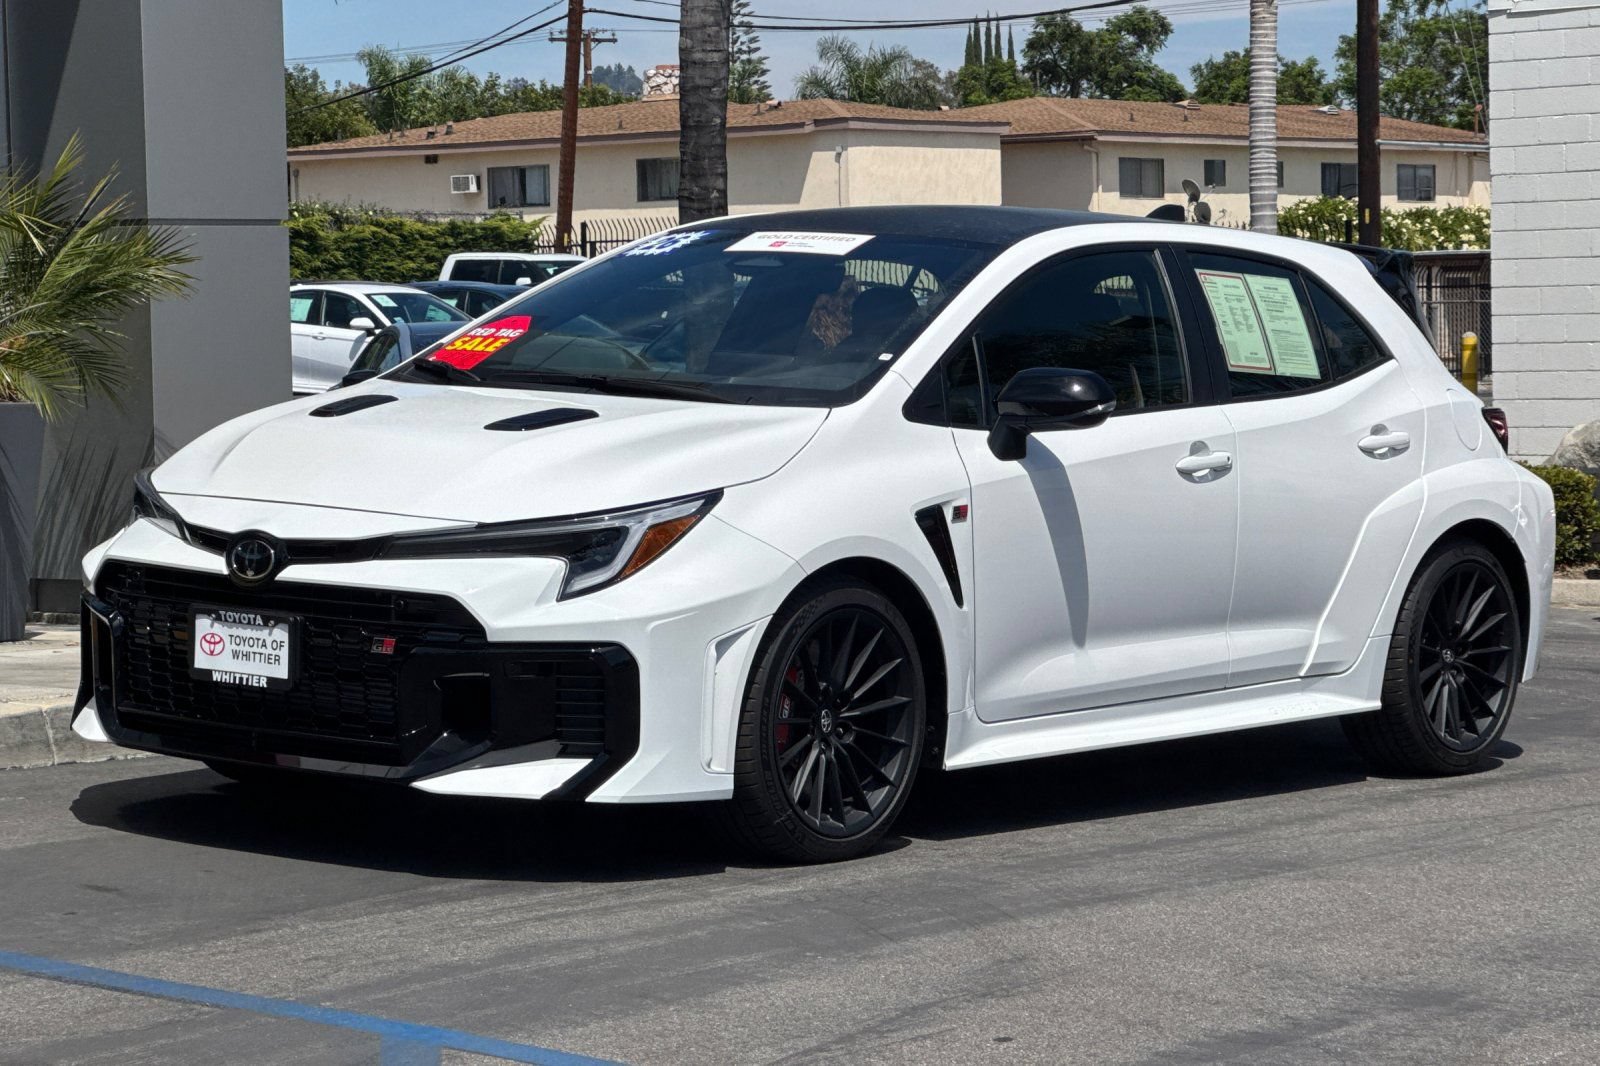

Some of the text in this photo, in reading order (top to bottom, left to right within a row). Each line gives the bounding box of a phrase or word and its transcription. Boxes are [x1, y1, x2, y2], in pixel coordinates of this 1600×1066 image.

[793, 234, 856, 242] CERTIFIED
[467, 327, 525, 337] RED TAG
[445, 337, 511, 352] SALE
[219, 611, 264, 626] TOYOTA
[228, 634, 285, 652] TOYOTA OF
[231, 649, 281, 666] WHITTIER
[212, 670, 268, 688] WHITTIER
